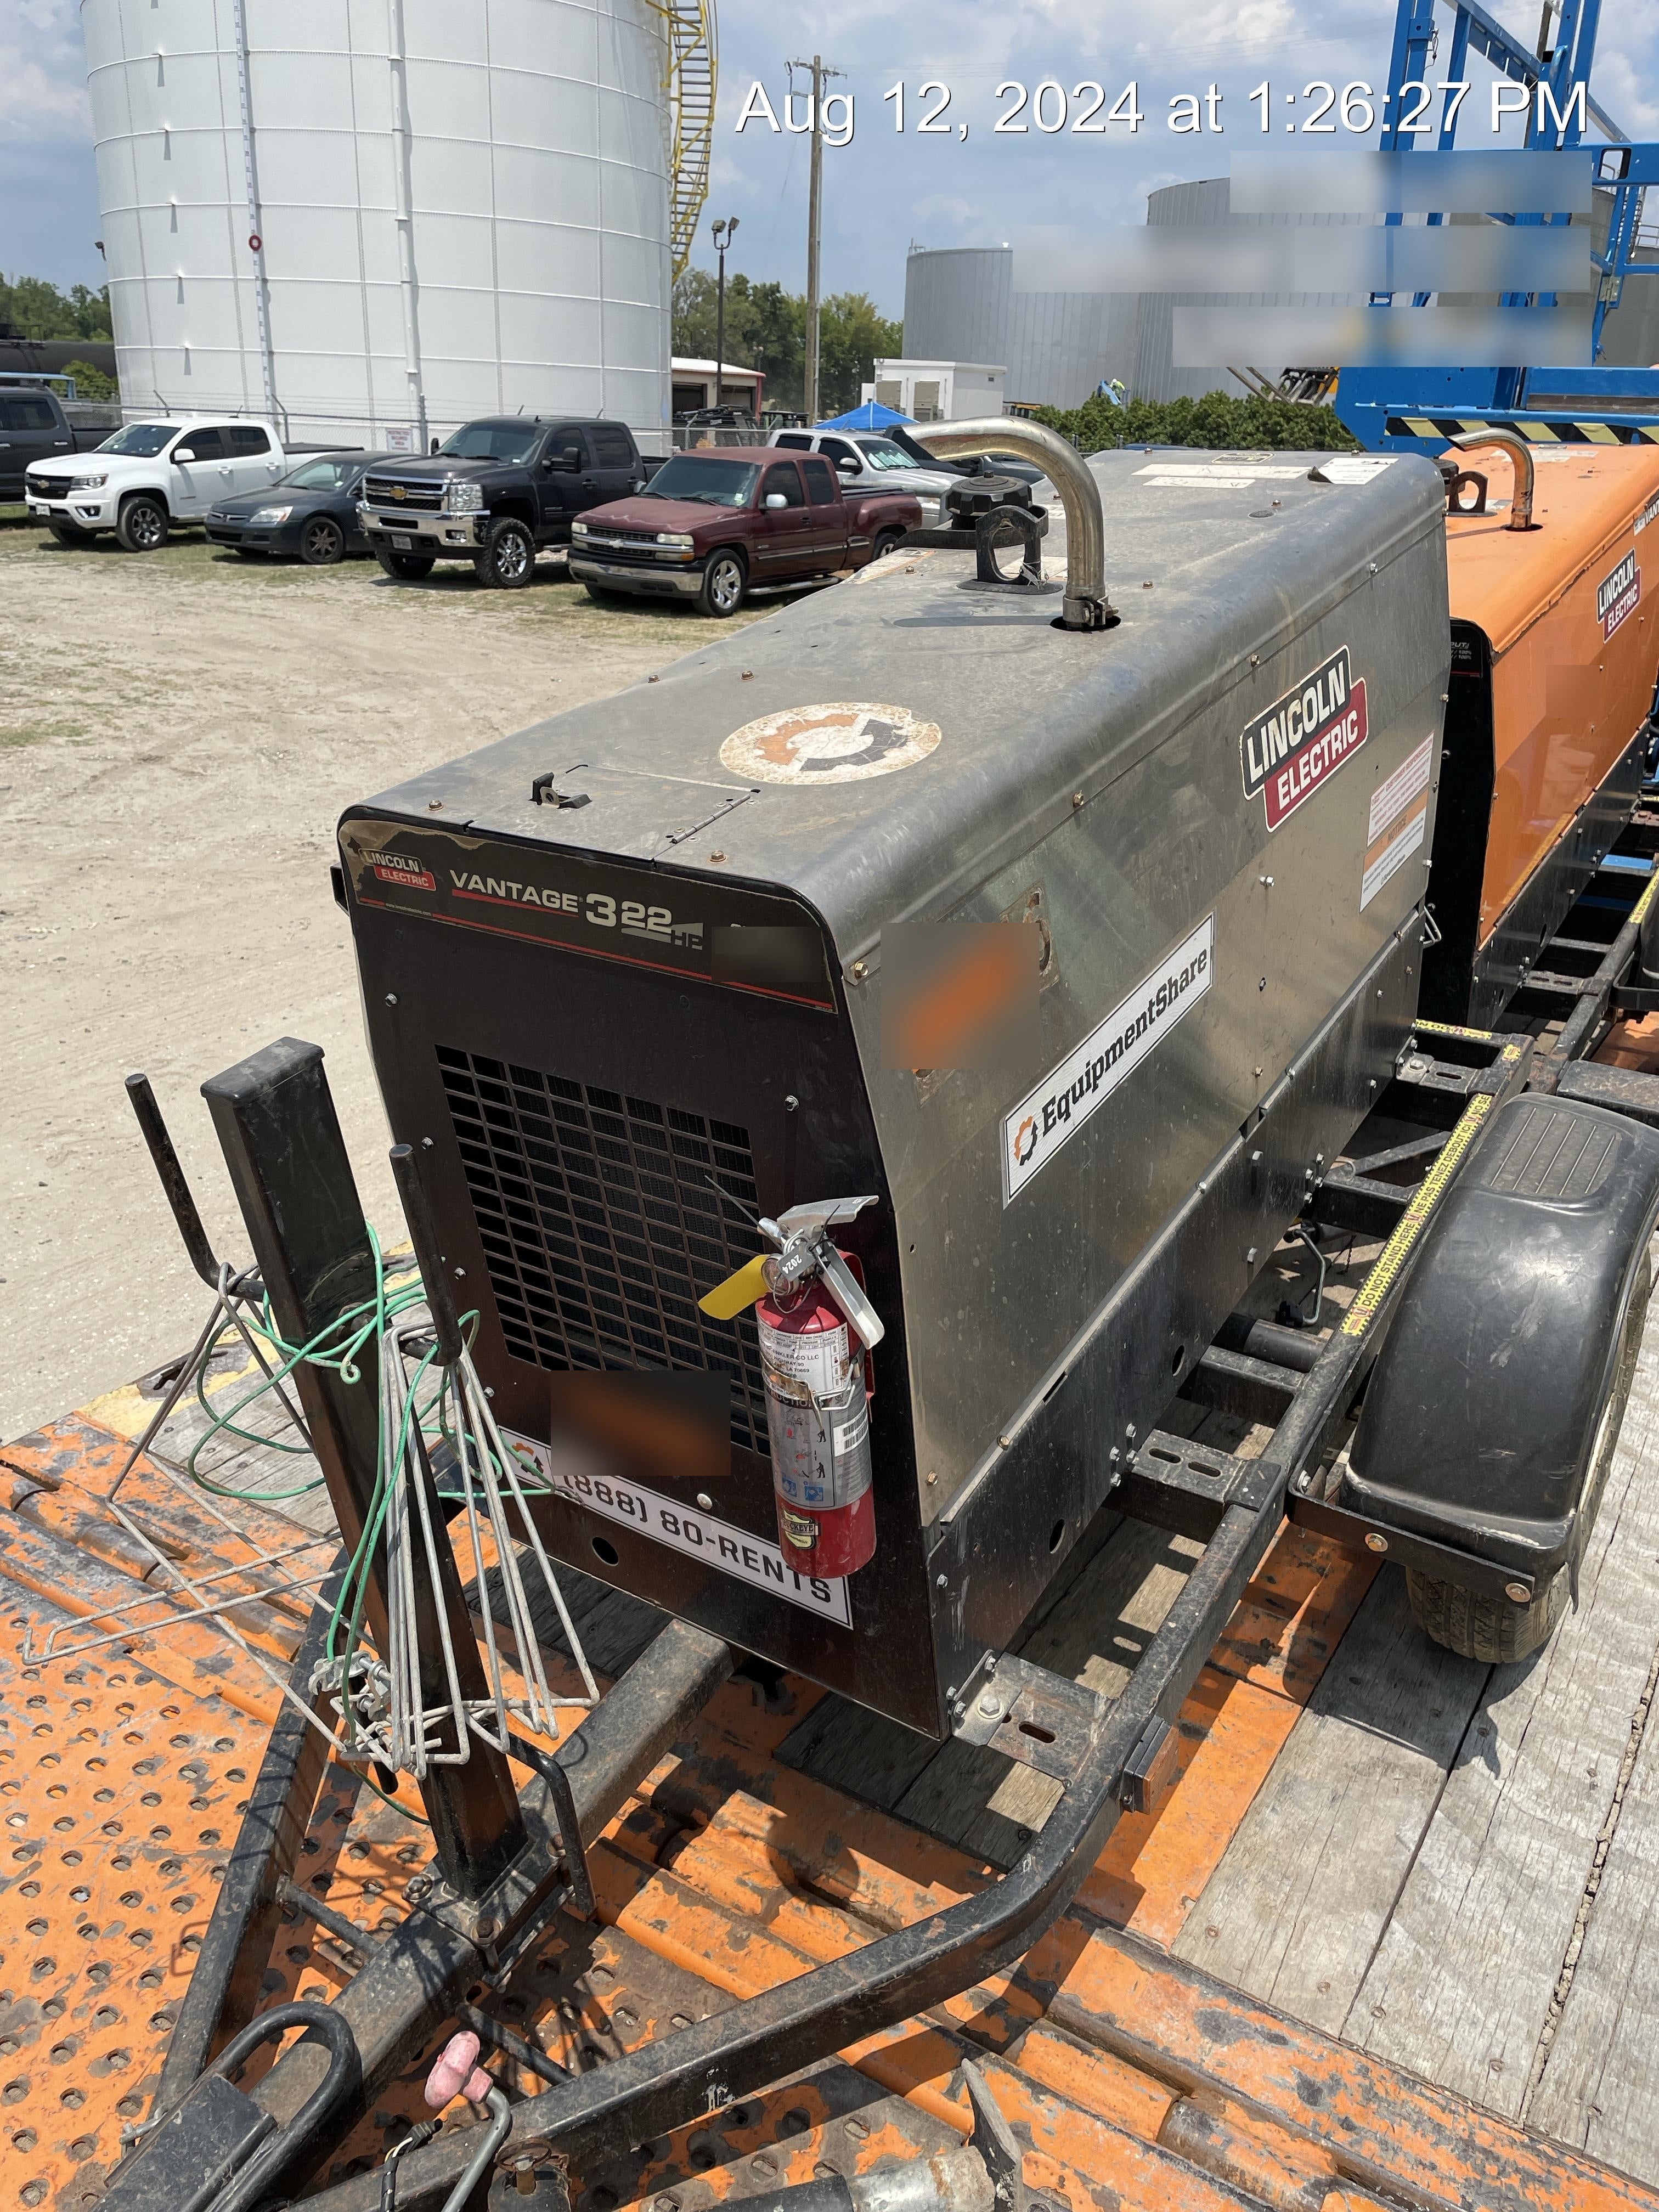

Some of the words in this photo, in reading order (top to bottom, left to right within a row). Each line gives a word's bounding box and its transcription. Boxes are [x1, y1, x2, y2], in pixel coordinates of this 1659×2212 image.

[1599, 556, 1634, 616] LINCOLN
[1607, 584, 1638, 633] ELECTRIC
[1248, 661, 1346, 784] LINCOLN
[1277, 709, 1358, 811] ELECTRIC
[363, 851, 420, 873] LINCOLN
[381, 868, 429, 887] ELECTRIC
[449, 870, 579, 913] VANTAGE
[585, 893, 672, 934] 322
[1042, 948, 1207, 1137] EquipmentShare
[1471, 1105, 1483, 1115] NO
[1414, 1202, 1427, 1214] NE
[1421, 1186, 1436, 1202] PAS
[1429, 1163, 1449, 1186] TENEZ
[1443, 1134, 1466, 1162] DEBOUT
[1462, 1124, 1472, 1135] ICI
[782, 1254, 802, 1274] 2024
[1361, 1293, 1376, 1307] DO
[1372, 1273, 1386, 1293] NOT
[1380, 1244, 1402, 1273] STAND
[1399, 1222, 1415, 1245] HERE
